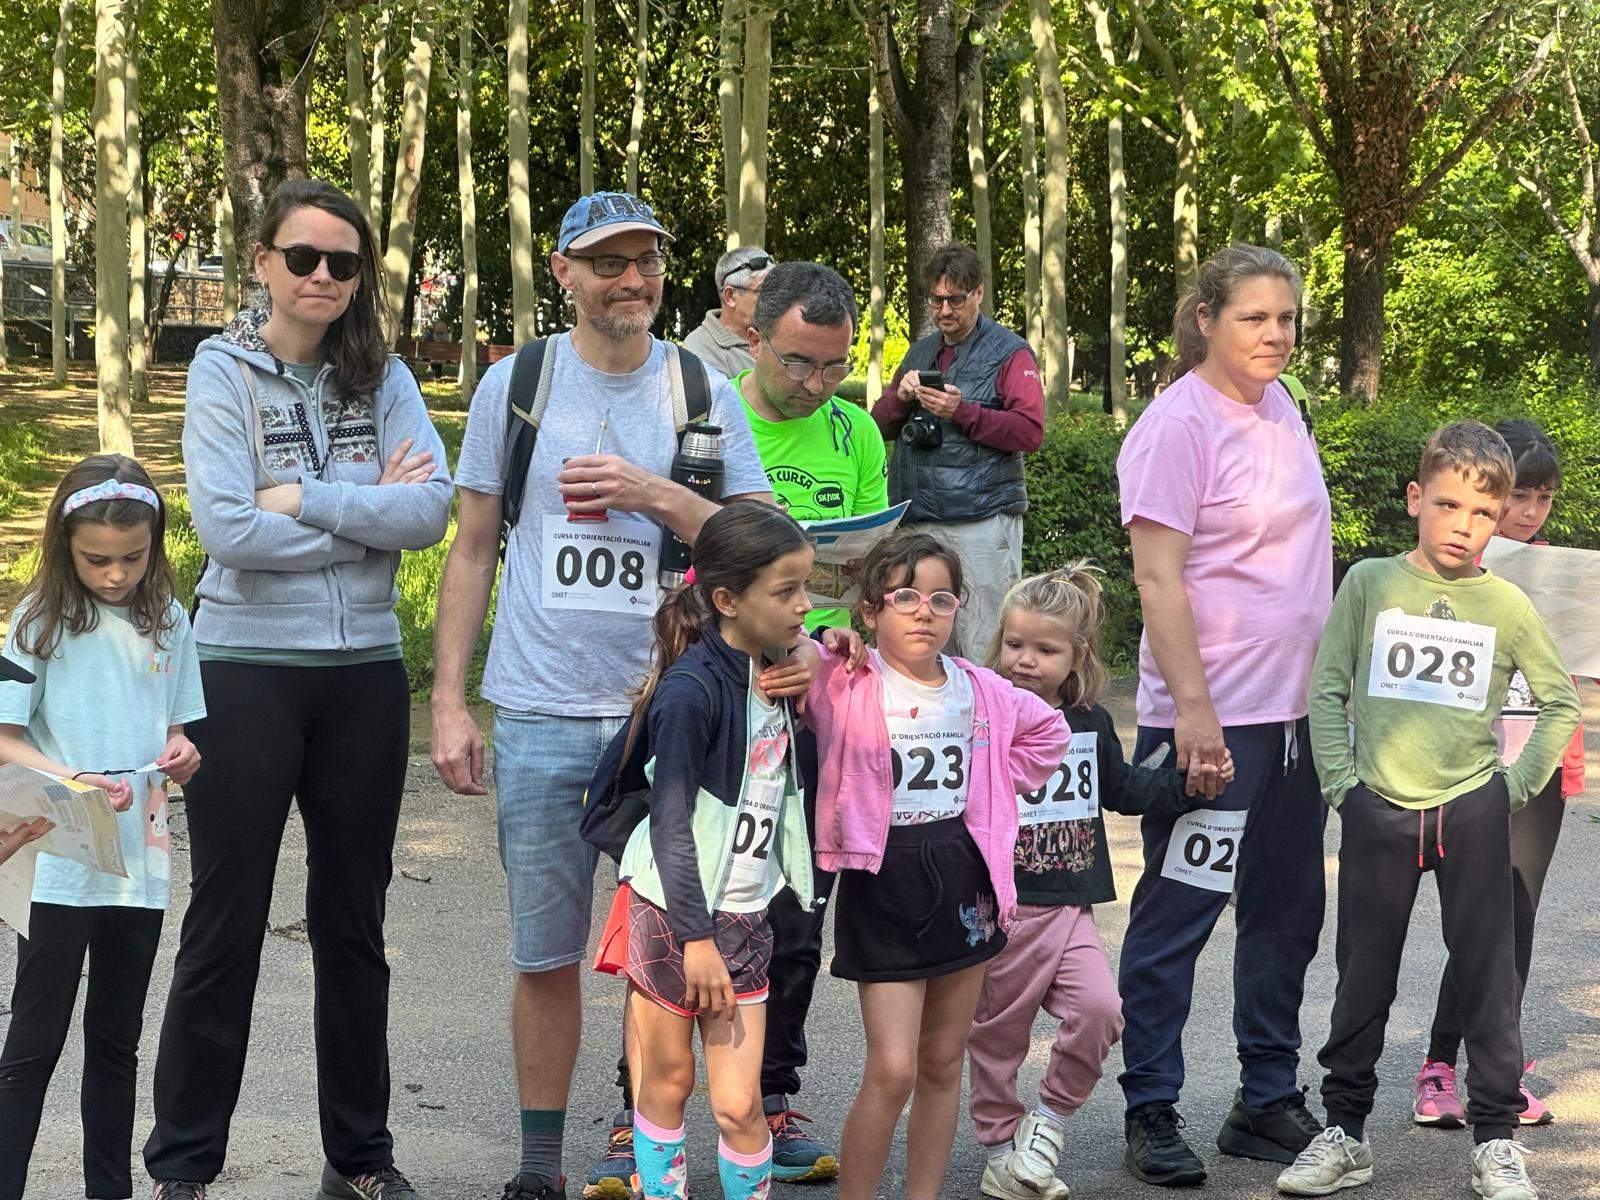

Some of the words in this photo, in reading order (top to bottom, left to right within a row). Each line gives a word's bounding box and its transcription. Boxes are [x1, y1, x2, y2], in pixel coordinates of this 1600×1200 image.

[776, 471, 813, 490] CURSA
[574, 534, 622, 543] D'ORIENTACIÓ
[623, 537, 651, 547] FAMILIAR
[556, 545, 645, 591] 008
[551, 591, 568, 599] OMET
[1387, 628, 1408, 636] CURSA
[1408, 631, 1454, 643] D'ORIENTACIÓ
[1454, 638, 1484, 648] FAMILIAR
[1387, 641, 1475, 688] 028
[891, 731, 942, 741] D'ORIENTACIÓ
[1019, 810, 1038, 818] OMET
[1187, 820, 1207, 829] CURSA
[731, 812, 774, 860] 02
[1184, 832, 1235, 873] 02
[1174, 866, 1193, 877] OMET
